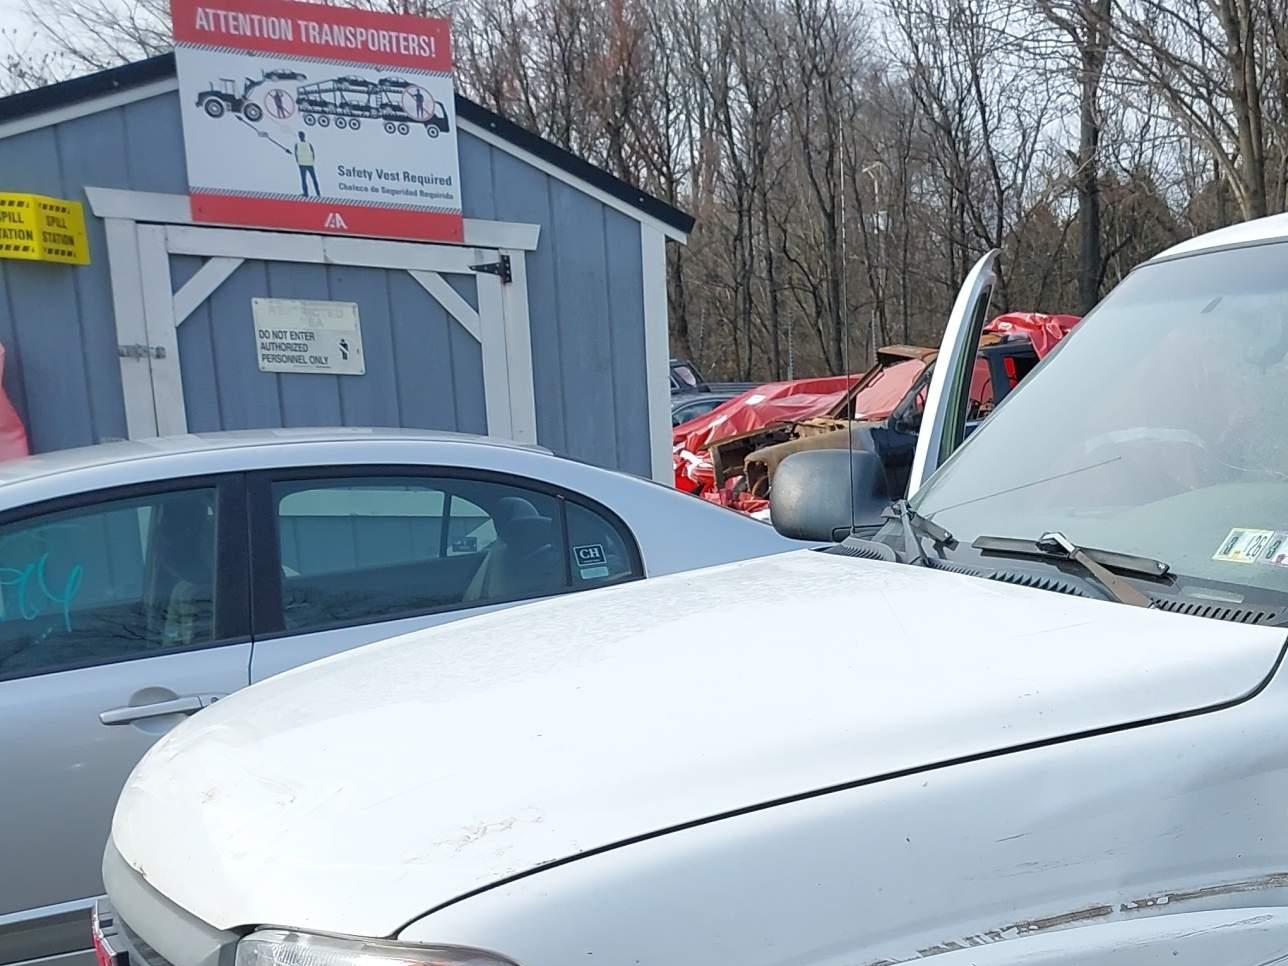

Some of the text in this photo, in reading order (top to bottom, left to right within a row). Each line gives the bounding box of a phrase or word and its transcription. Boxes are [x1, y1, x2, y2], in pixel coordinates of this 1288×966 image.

[195, 7, 436, 58] ATTENTION TRANSPORTERS!
[337, 165, 452, 187] Safety Vest Required
[0, 211, 24, 224] PILL
[46, 215, 68, 230] SPILL
[42, 231, 75, 246] STATION
[258, 329, 316, 341] DO NOT ENTER
[261, 342, 309, 353] AUTHORIZED
[262, 354, 329, 366] PERSONNEL ONLY
[579, 547, 601, 560] CH
